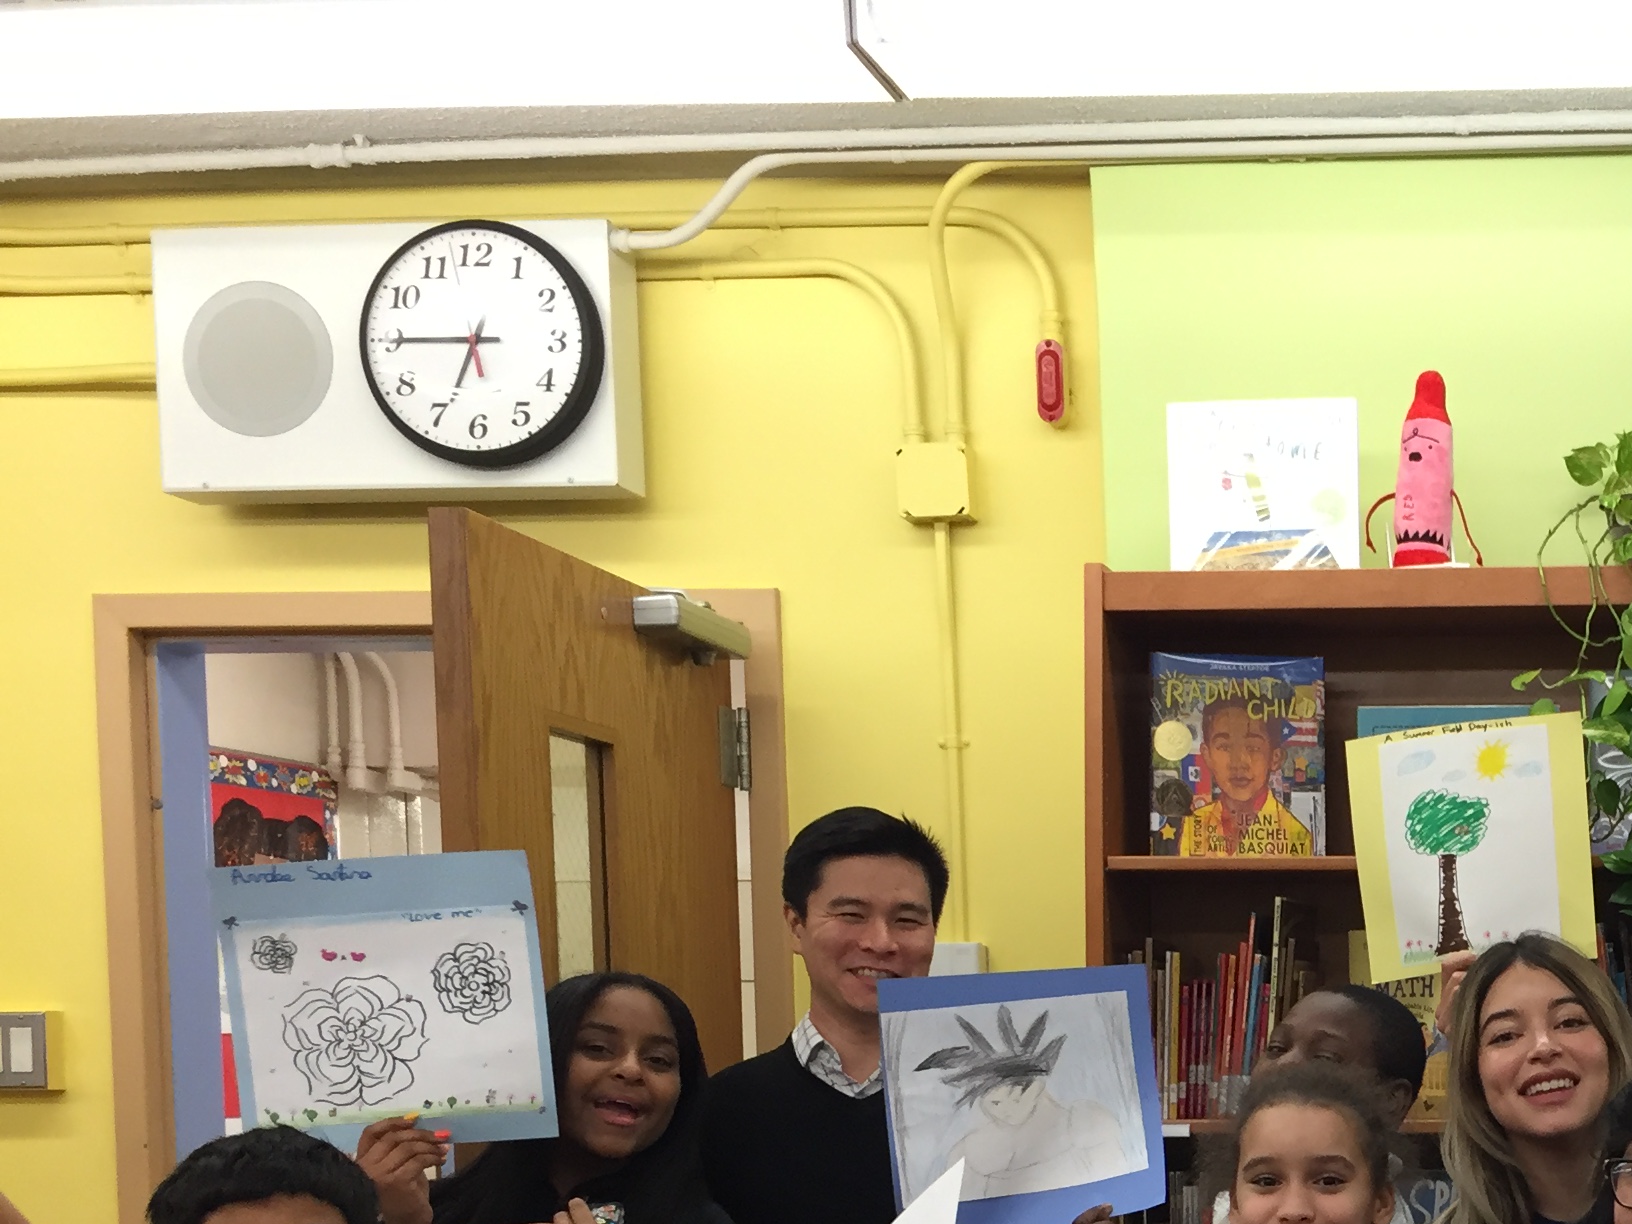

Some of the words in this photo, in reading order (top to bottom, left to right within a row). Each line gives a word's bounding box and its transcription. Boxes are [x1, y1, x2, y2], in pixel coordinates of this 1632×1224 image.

[459, 242, 492, 268] 12
[420, 256, 448, 280] 11
[511, 256, 524, 280] 1
[390, 284, 421, 310] 10
[538, 288, 556, 313] 2
[385, 328, 404, 353] 9
[547, 329, 567, 354] 3
[396, 370, 417, 396] 8
[536, 367, 555, 393] 4
[430, 402, 450, 428] 7
[468, 414, 489, 440] 6
[512, 401, 531, 428] 5
[1166, 676, 1281, 708] RADIANT
[1247, 697, 1317, 722] CHILD
[1384, 735, 1393, 744] A
[1403, 730, 1435, 740] Summer
[1237, 814, 1279, 827] JEAN-
[1239, 828, 1288, 841] MICHEL
[1239, 842, 1306, 855] BASQUIAT
